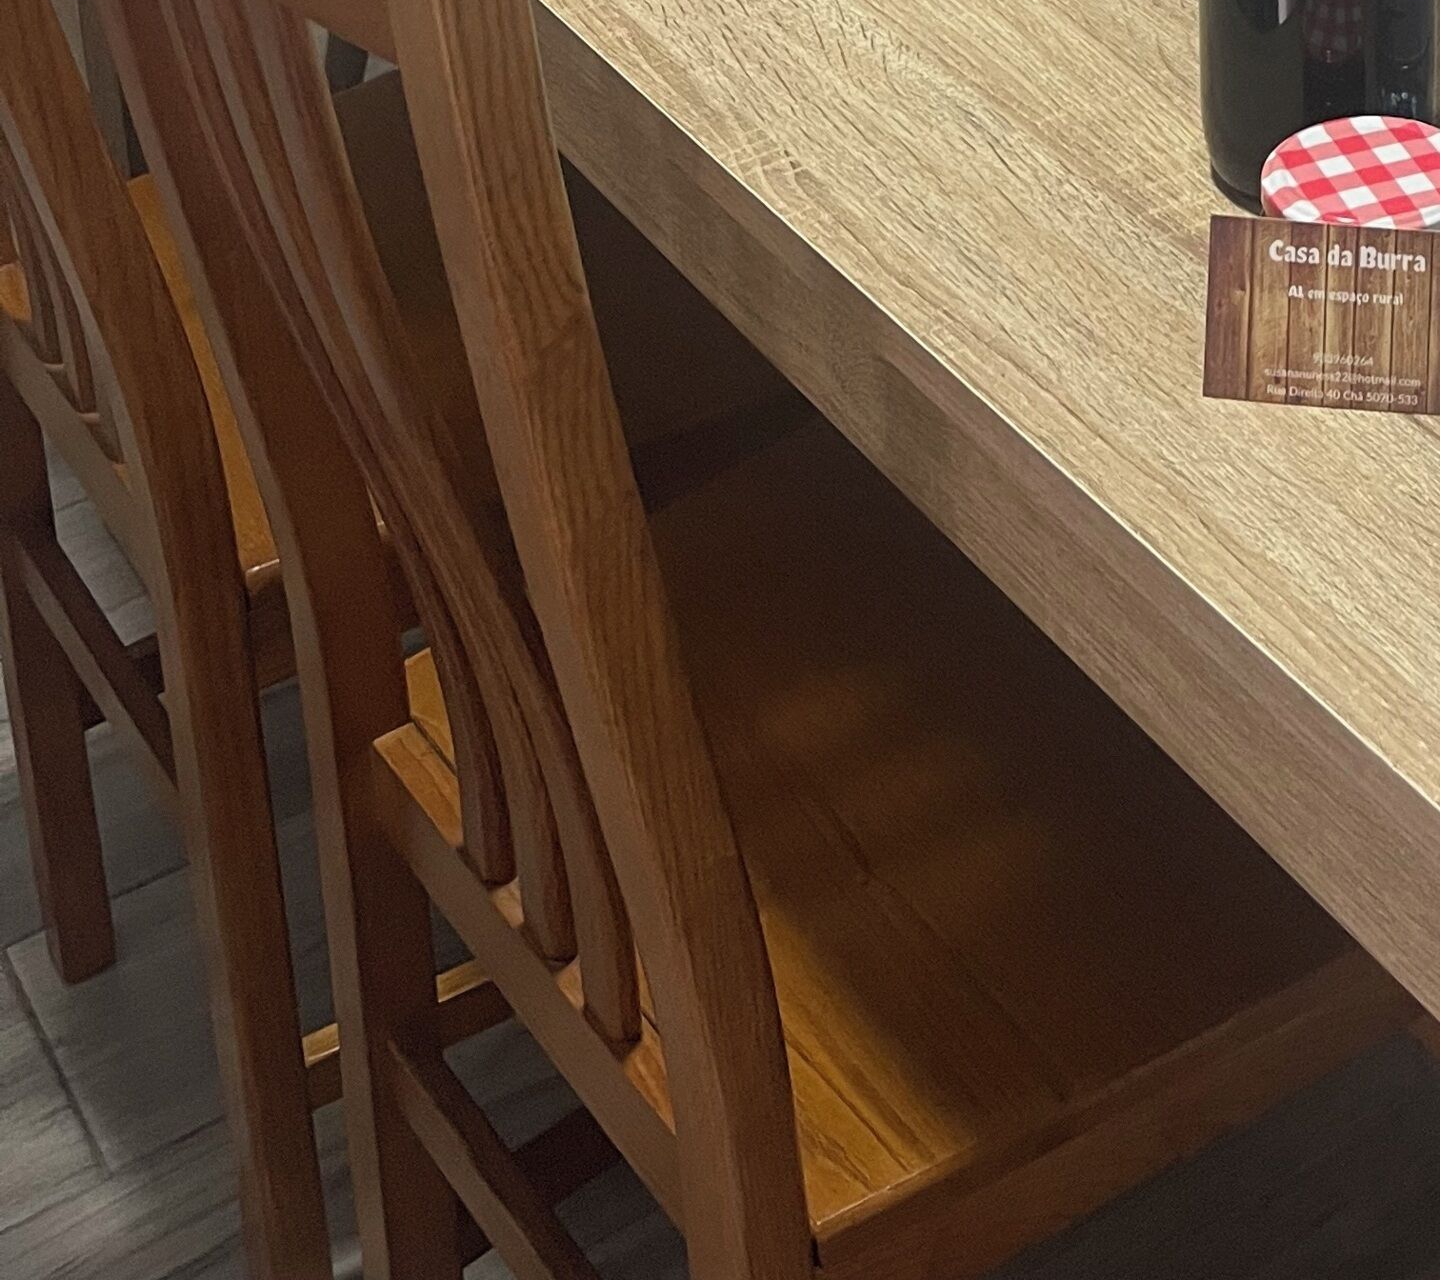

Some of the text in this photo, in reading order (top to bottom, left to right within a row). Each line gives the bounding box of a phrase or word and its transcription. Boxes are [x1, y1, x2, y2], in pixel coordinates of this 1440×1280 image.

[1269, 239, 1426, 272] Casa da Burra
